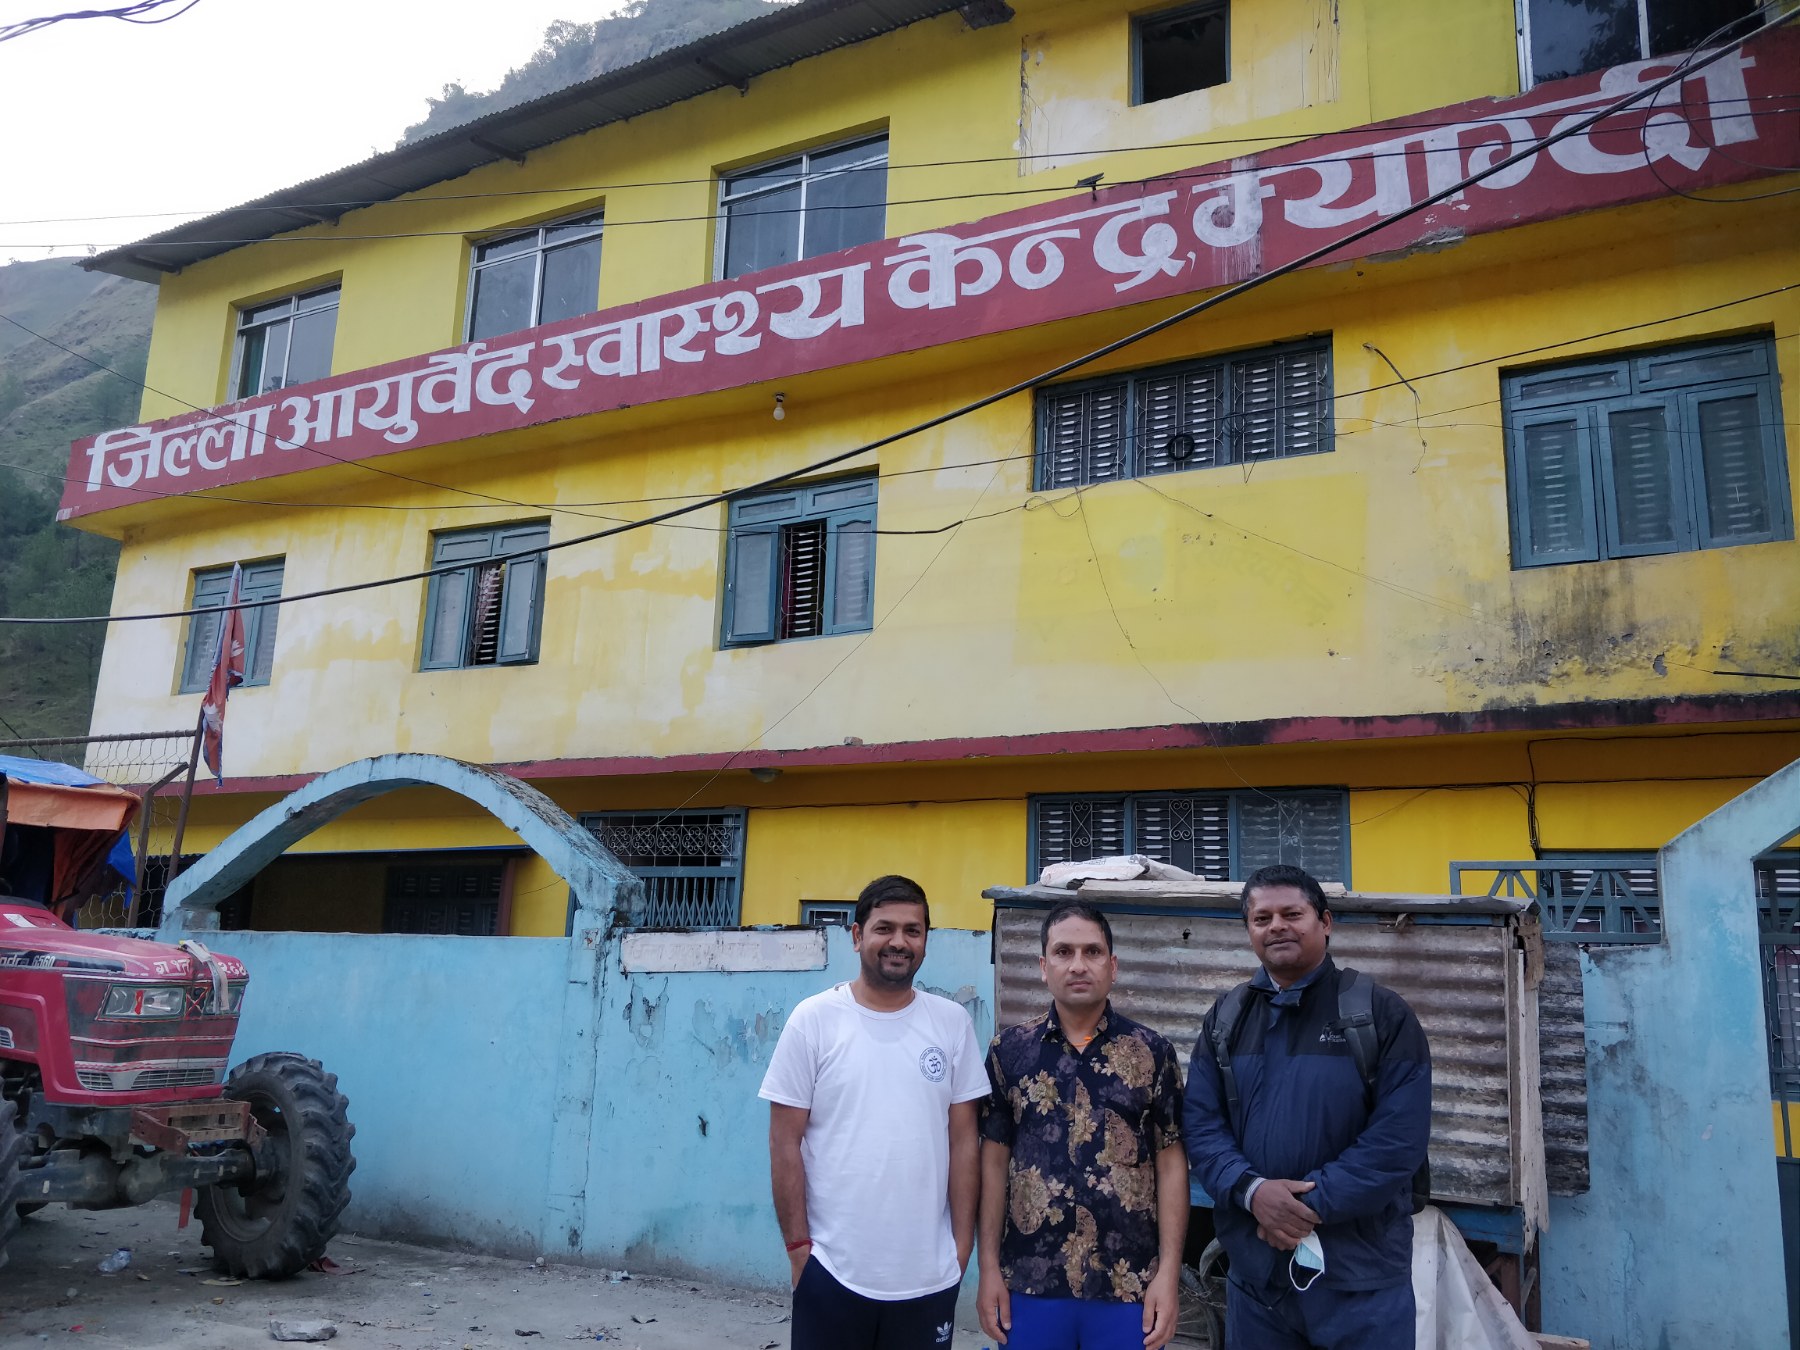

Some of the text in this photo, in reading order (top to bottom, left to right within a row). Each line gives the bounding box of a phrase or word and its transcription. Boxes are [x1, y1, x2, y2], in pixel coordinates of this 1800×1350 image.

[87, 404, 277, 492] जिल्ला
[274, 342, 536, 445] आयुर्वेद
[541, 261, 872, 390] स्वास्थ्य
